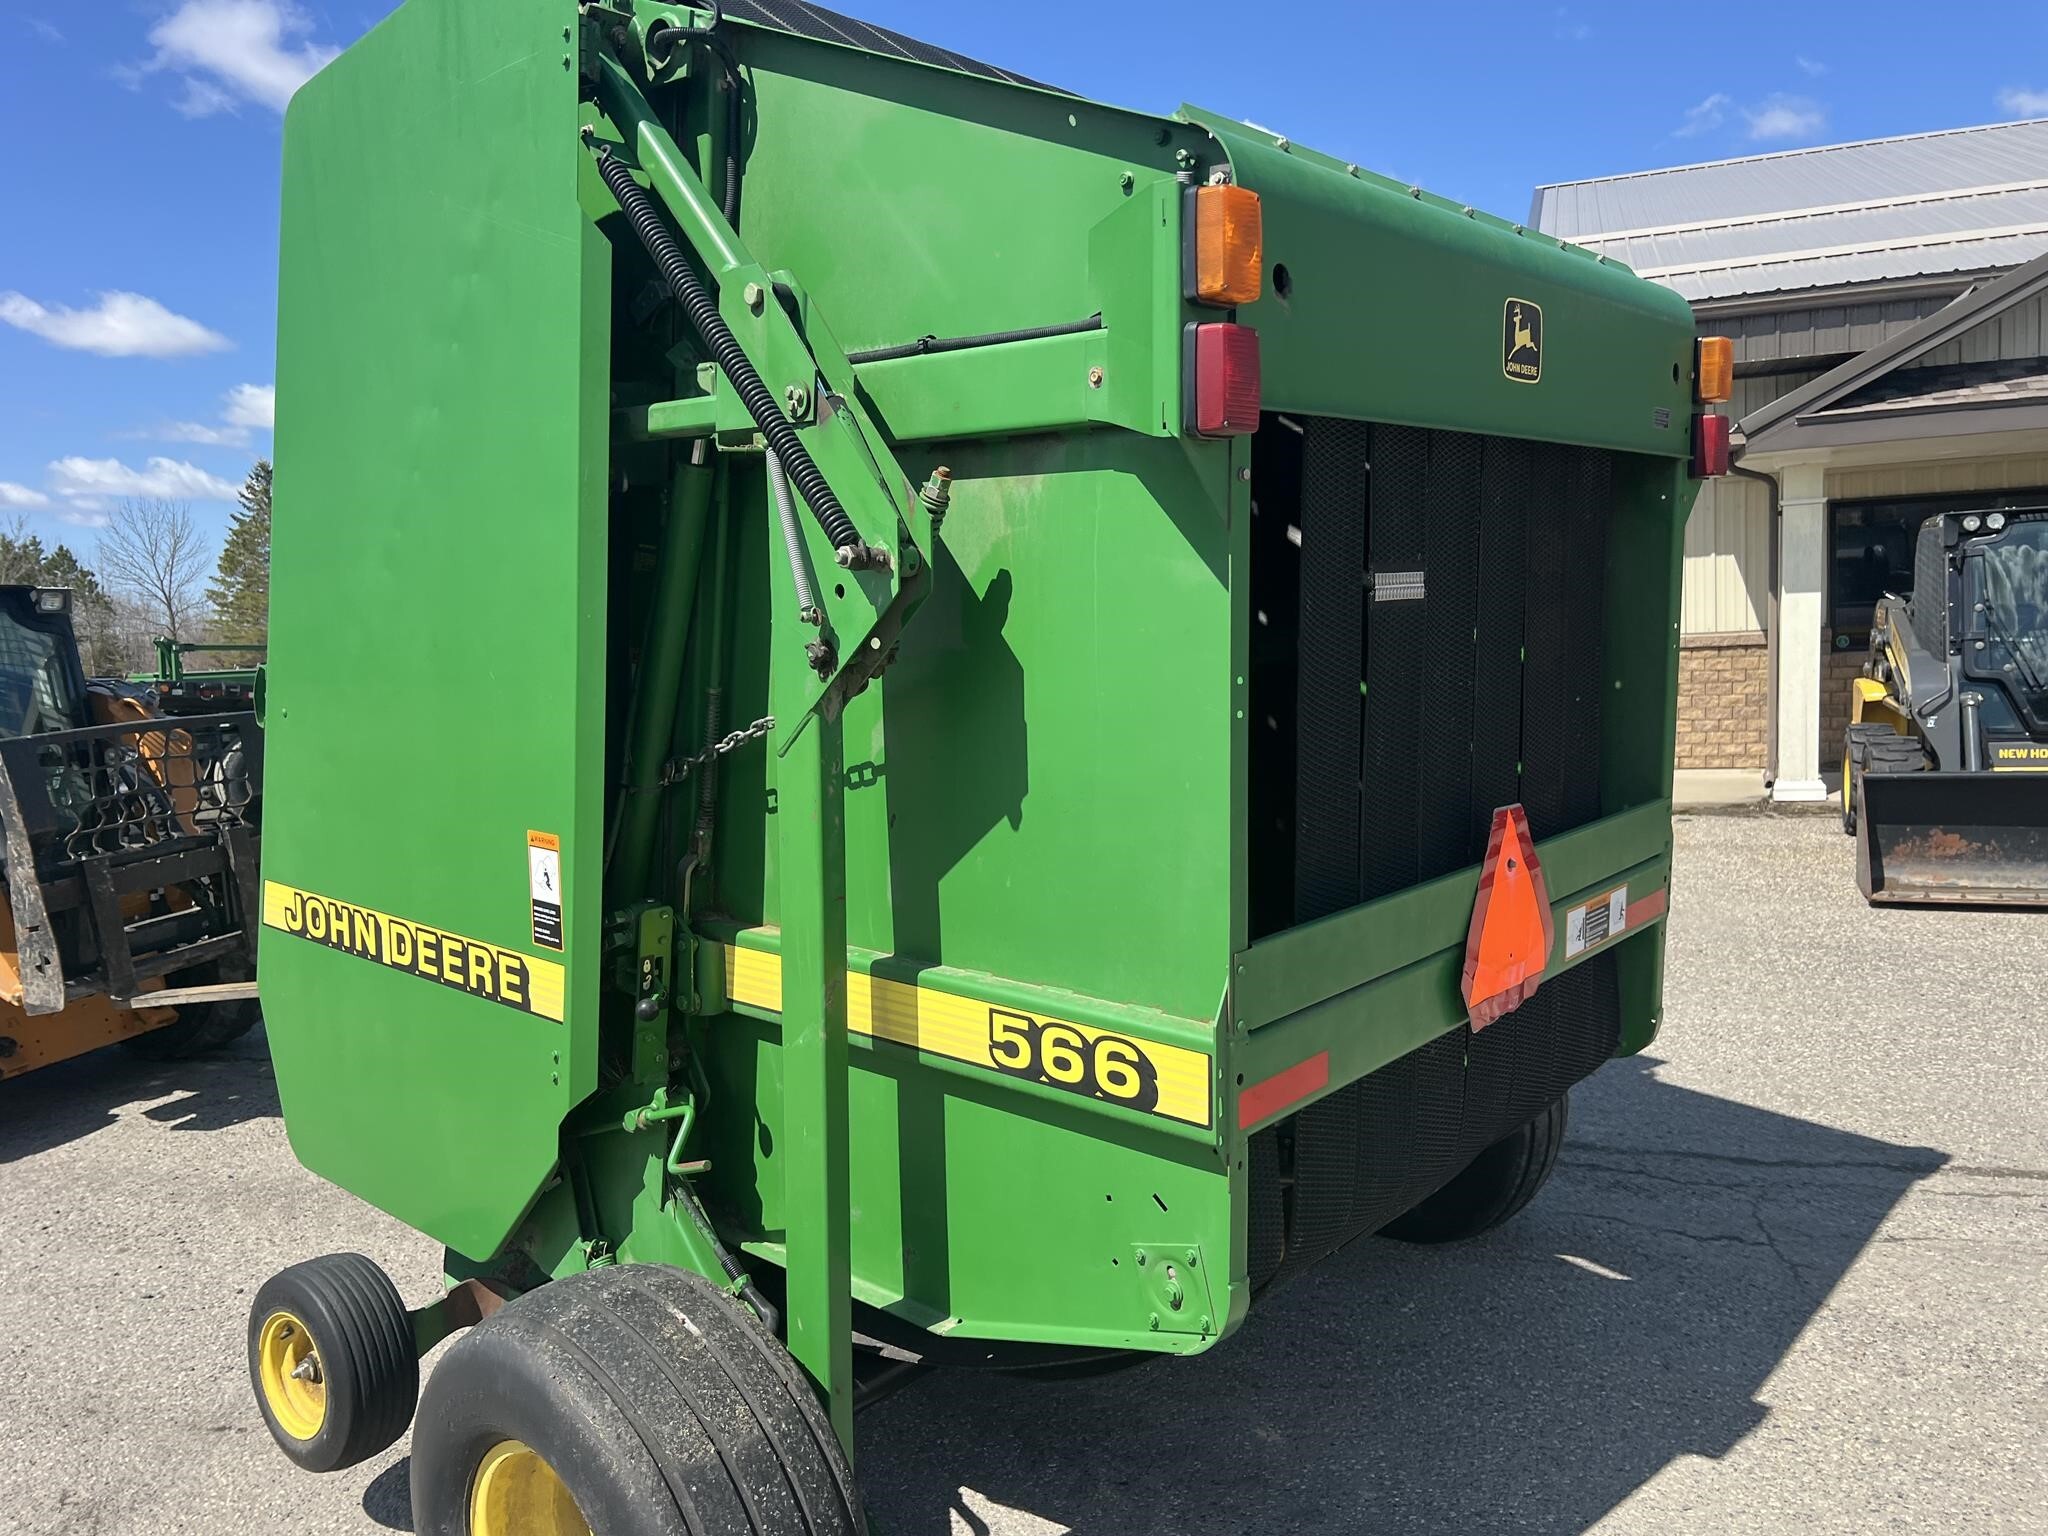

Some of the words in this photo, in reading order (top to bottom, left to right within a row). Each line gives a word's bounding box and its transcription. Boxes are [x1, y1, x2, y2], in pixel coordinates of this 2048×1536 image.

[1506, 362, 1520, 373] JOHN
[1521, 364, 1538, 376] DEERE
[1999, 748, 2028, 759] NEW
[285, 892, 381, 957] JOHN
[387, 918, 530, 1010] DEERE
[989, 1008, 1157, 1112] 566
